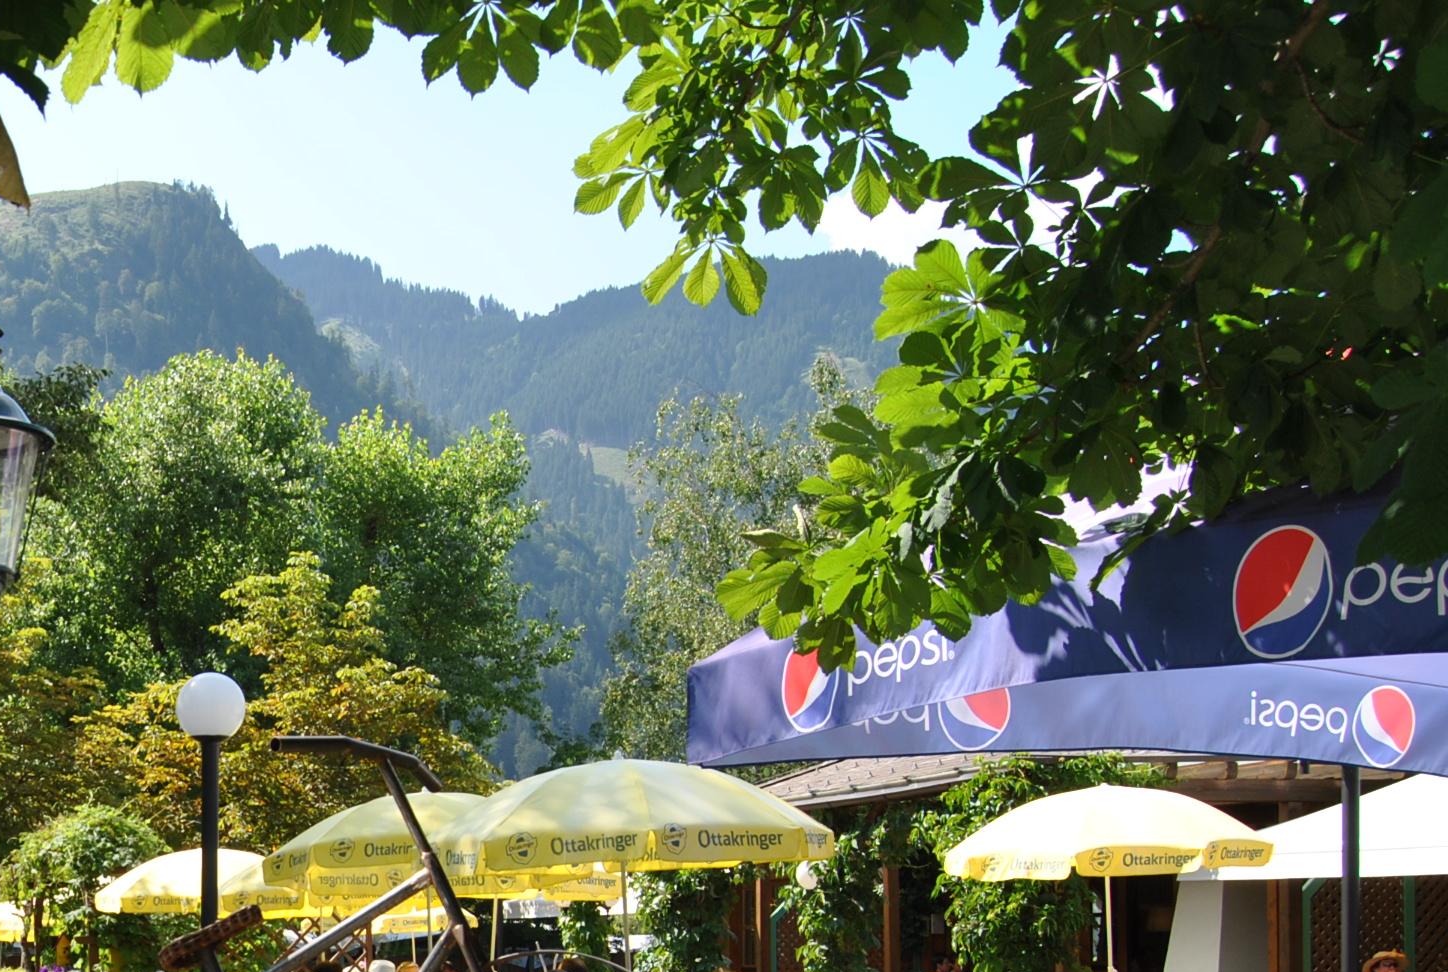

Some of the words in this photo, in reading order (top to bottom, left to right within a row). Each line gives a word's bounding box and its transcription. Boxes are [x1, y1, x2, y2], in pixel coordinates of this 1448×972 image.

[550, 832, 638, 855] Ottakringer
[698, 829, 783, 850] Ottakringer
[1123, 852, 1195, 868] Ottakringer
[1220, 846, 1264, 860] Ottakringer
